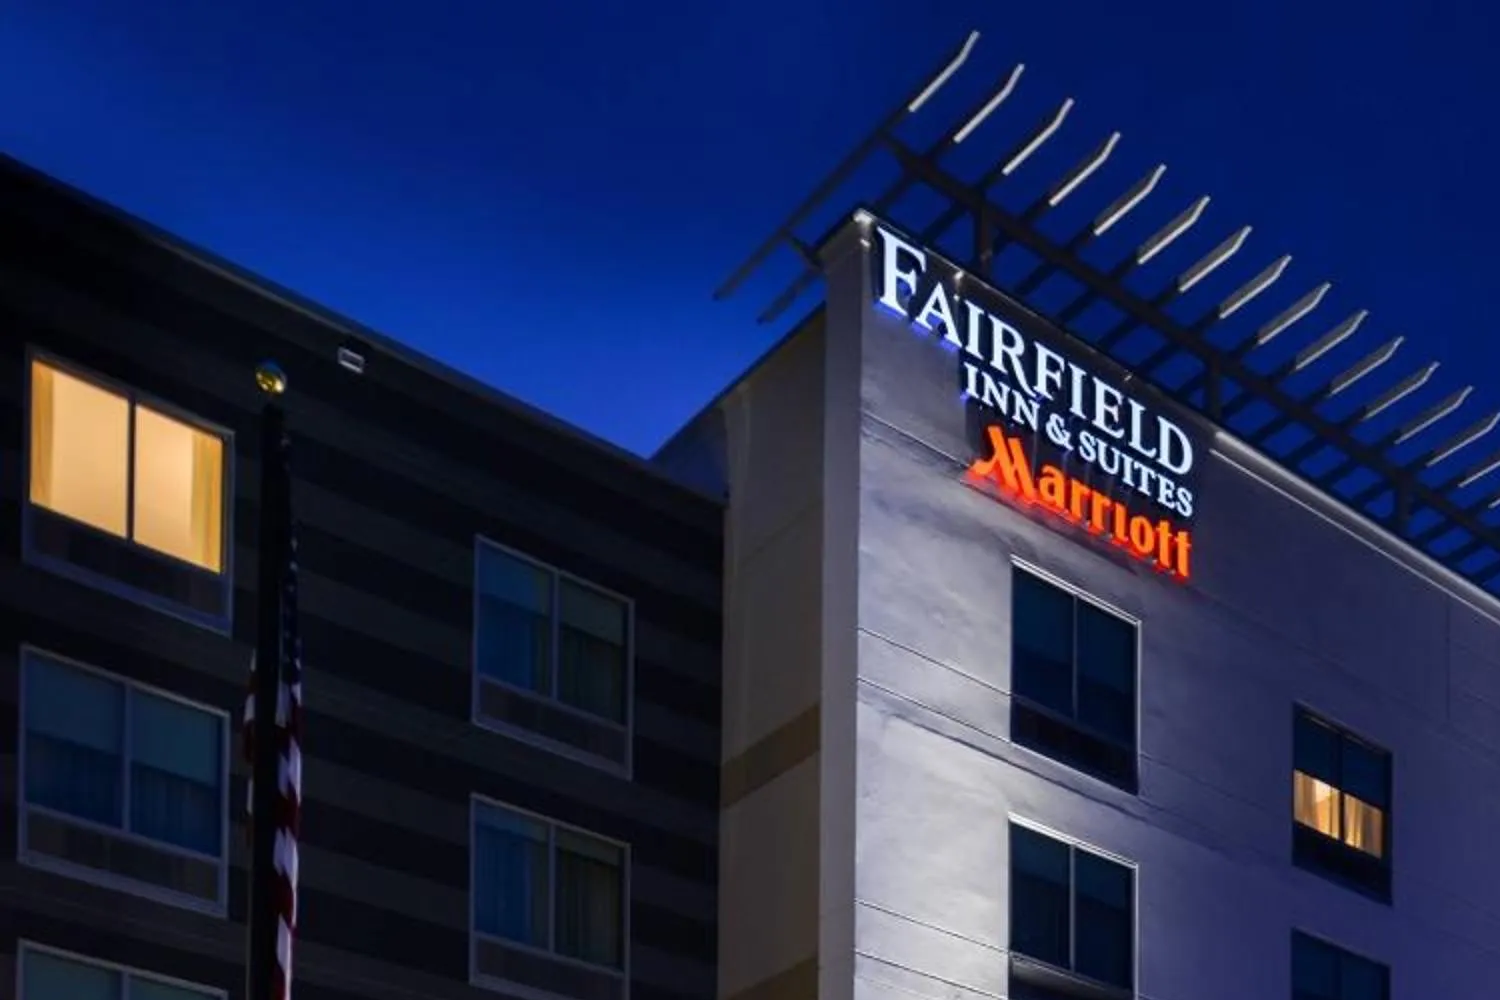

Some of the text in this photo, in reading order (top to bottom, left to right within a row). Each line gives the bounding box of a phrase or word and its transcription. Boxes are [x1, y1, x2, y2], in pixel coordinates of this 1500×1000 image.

[877, 226, 1193, 475] FAIRFIELD
[963, 362, 1193, 517] INN & SUITES
[967, 425, 1192, 578] Marriott
